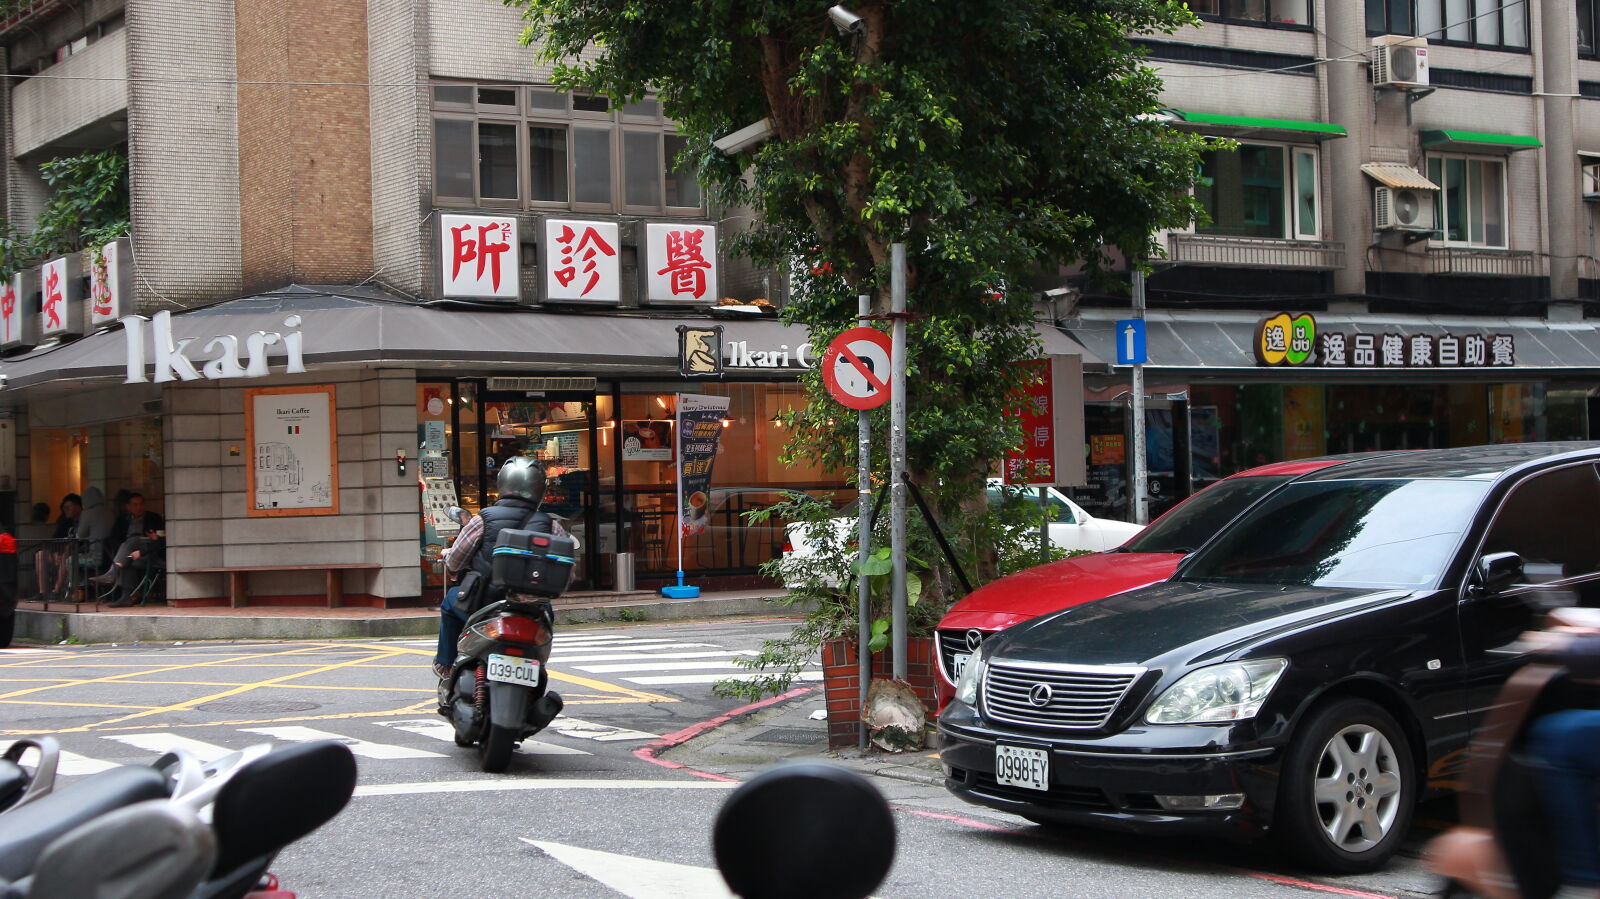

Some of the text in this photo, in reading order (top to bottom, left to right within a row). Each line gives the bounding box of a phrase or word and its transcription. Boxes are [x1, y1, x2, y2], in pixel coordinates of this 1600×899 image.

[451, 222, 510, 293] 所
[554, 225, 616, 297] 診
[657, 229, 712, 299] 醫
[43, 264, 62, 329] 安
[119, 310, 305, 384] Ikari
[728, 341, 789, 368] Ikari
[1323, 333, 1515, 366] 逸品健康自助餐
[490, 663, 536, 682] 039-CUL
